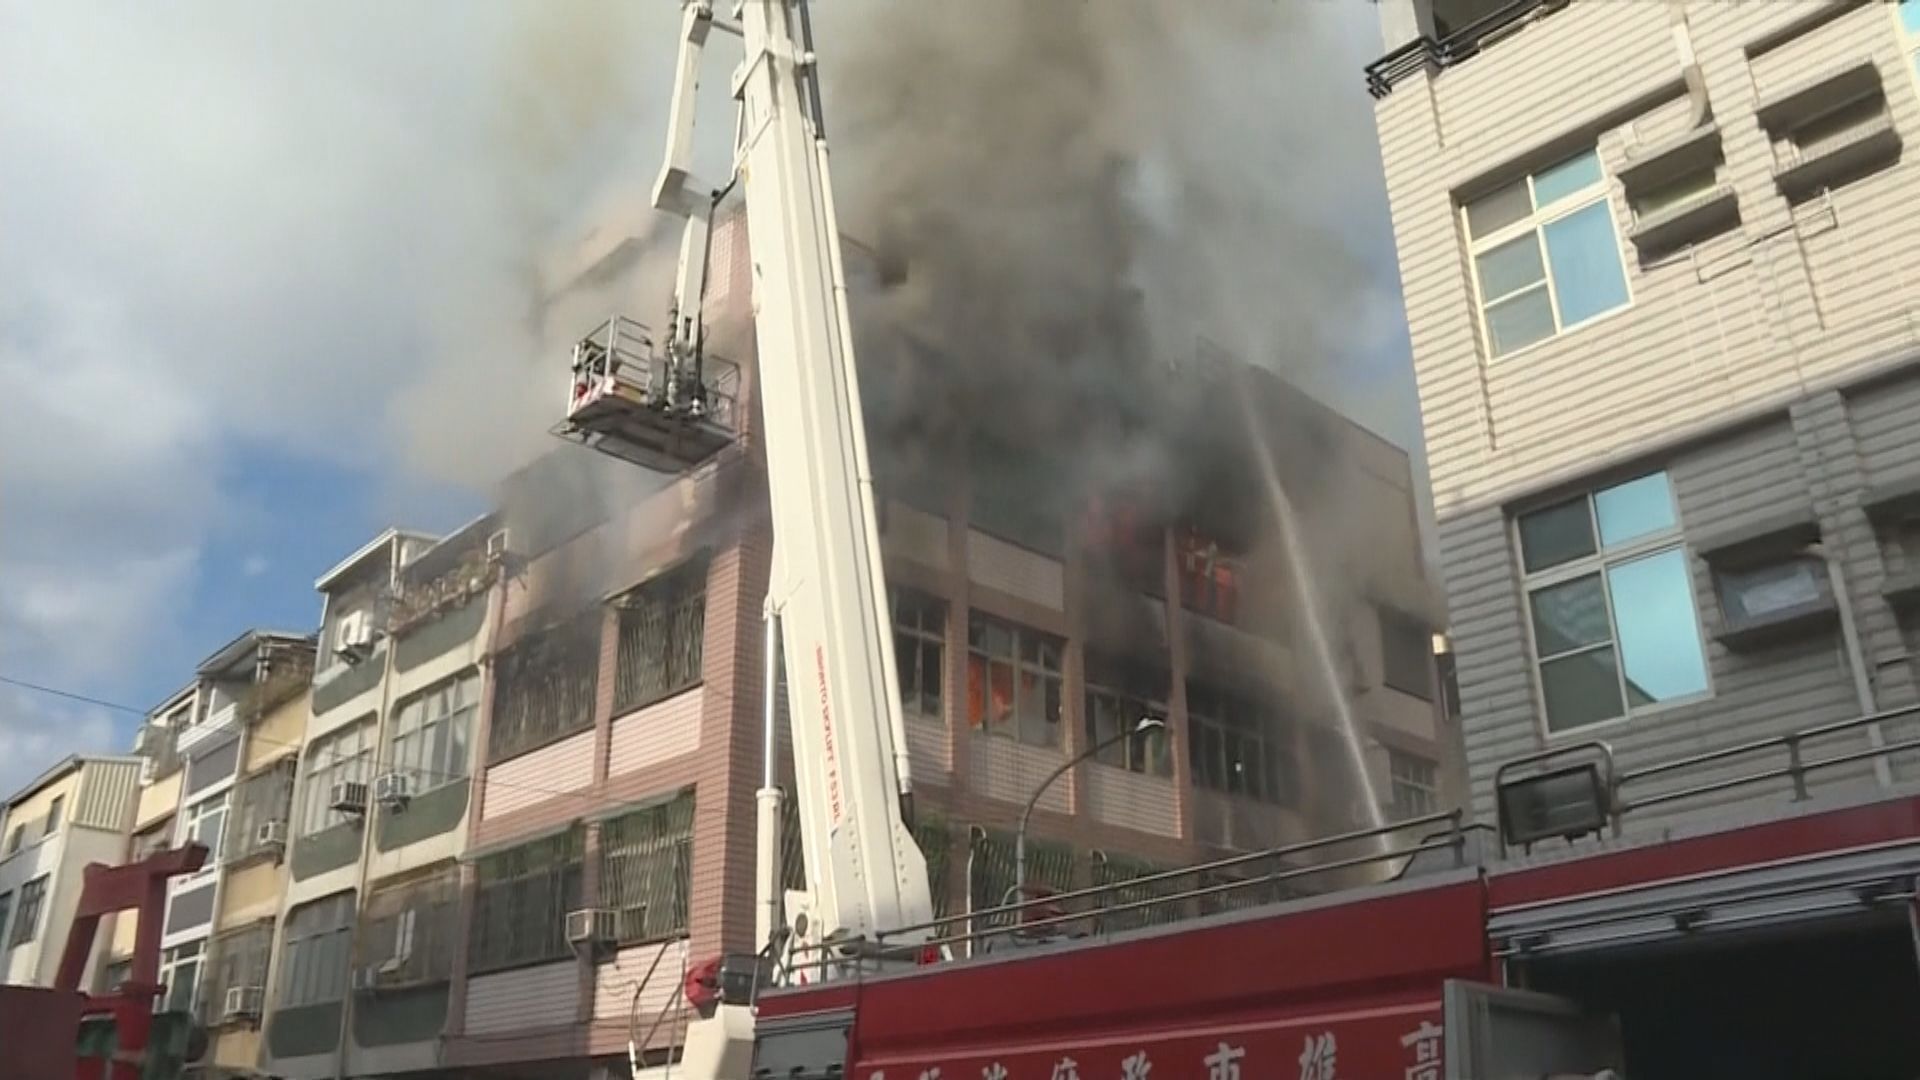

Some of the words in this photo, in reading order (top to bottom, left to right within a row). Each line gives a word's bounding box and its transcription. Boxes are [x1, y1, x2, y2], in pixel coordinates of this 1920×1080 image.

[868, 1021, 1443, 1080] 高雄市政府
